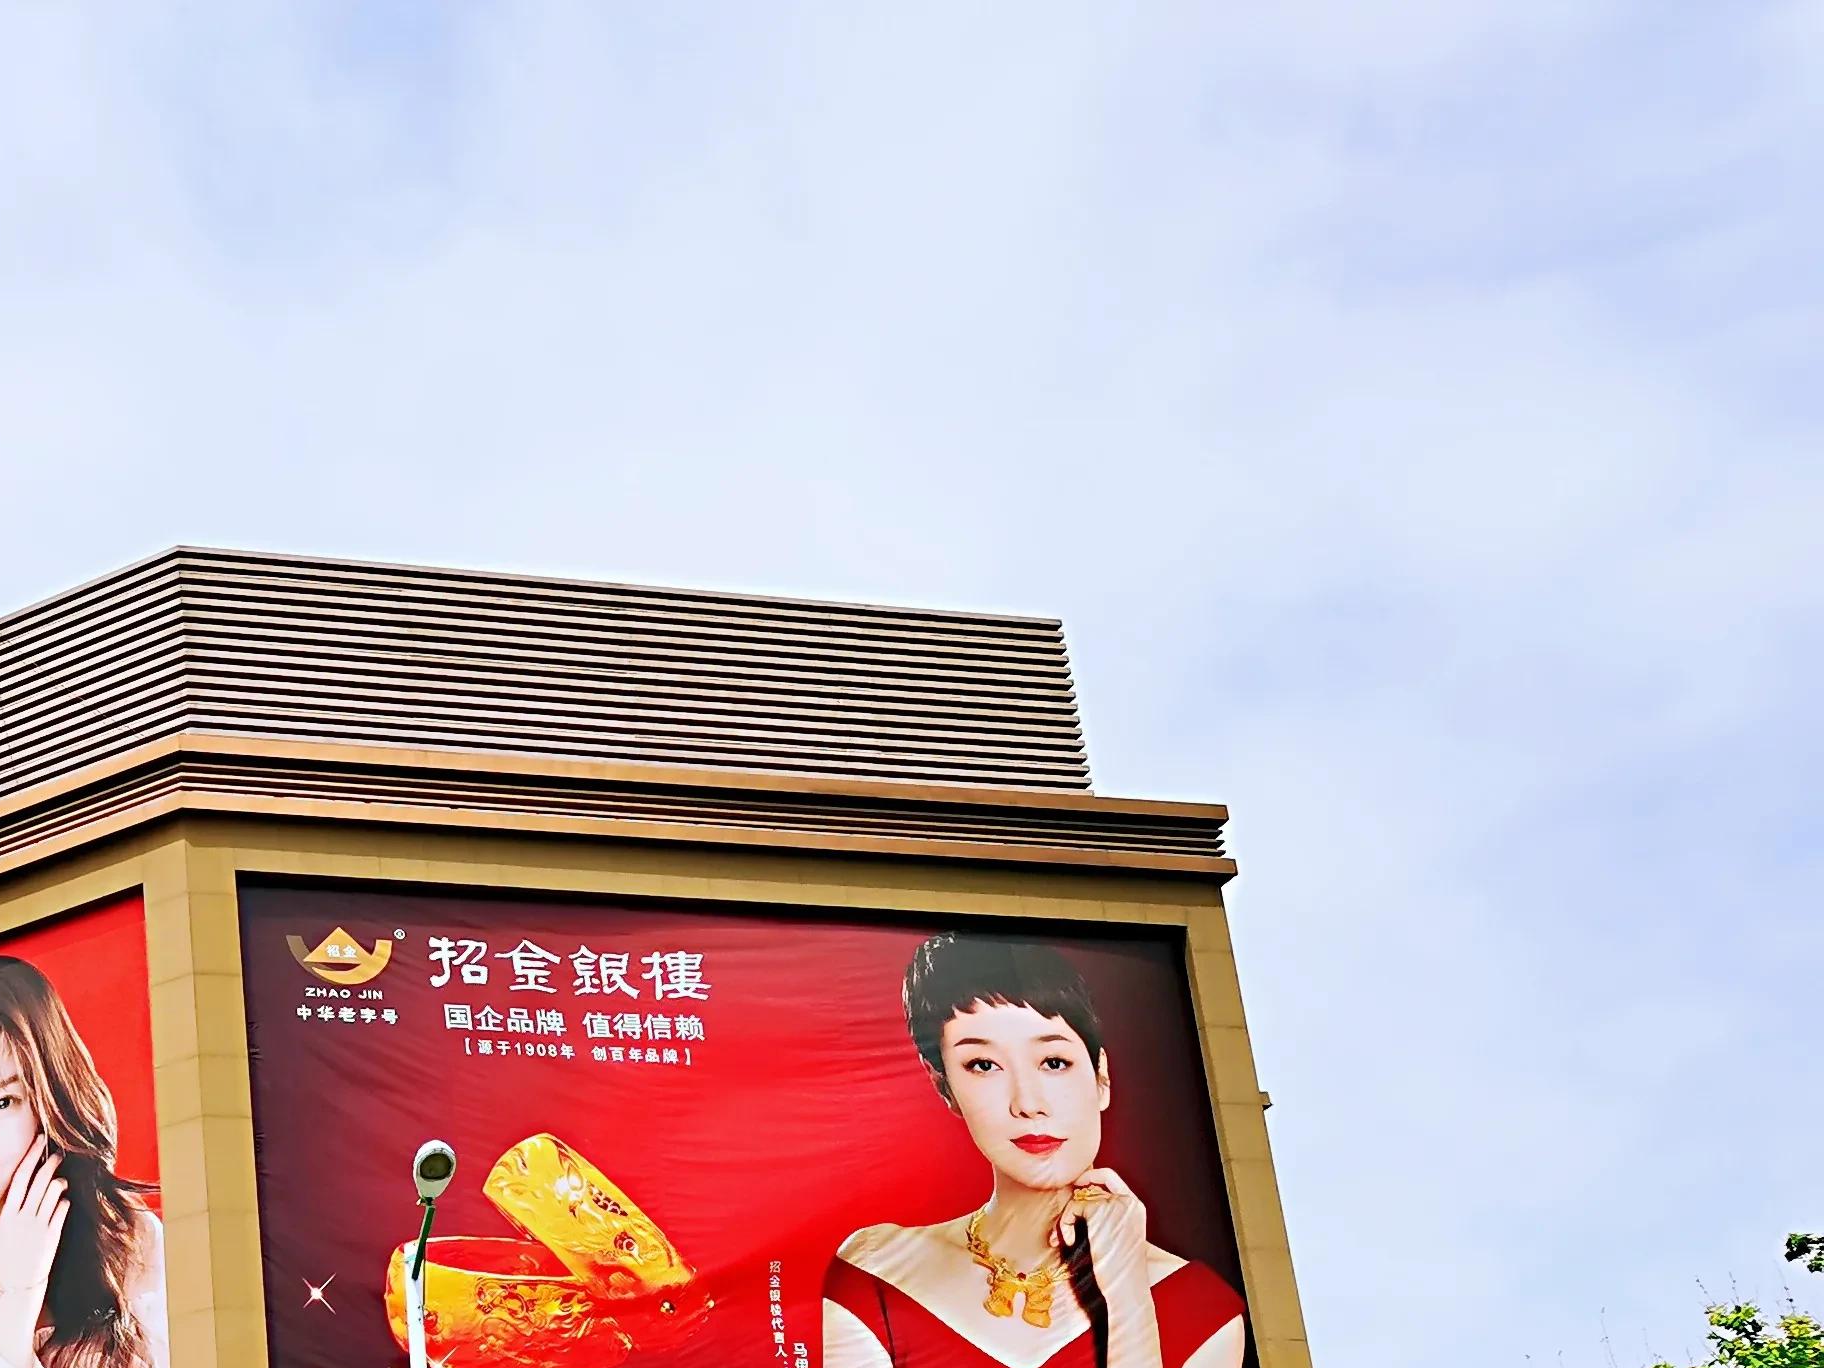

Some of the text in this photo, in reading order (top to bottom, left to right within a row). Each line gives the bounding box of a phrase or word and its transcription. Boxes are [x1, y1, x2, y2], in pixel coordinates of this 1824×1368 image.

[304, 986, 384, 1001] ZHAO JIN
[296, 1004, 398, 1025] 中华老字号
[443, 1003, 706, 1041] 国企品牌 值得信赖
